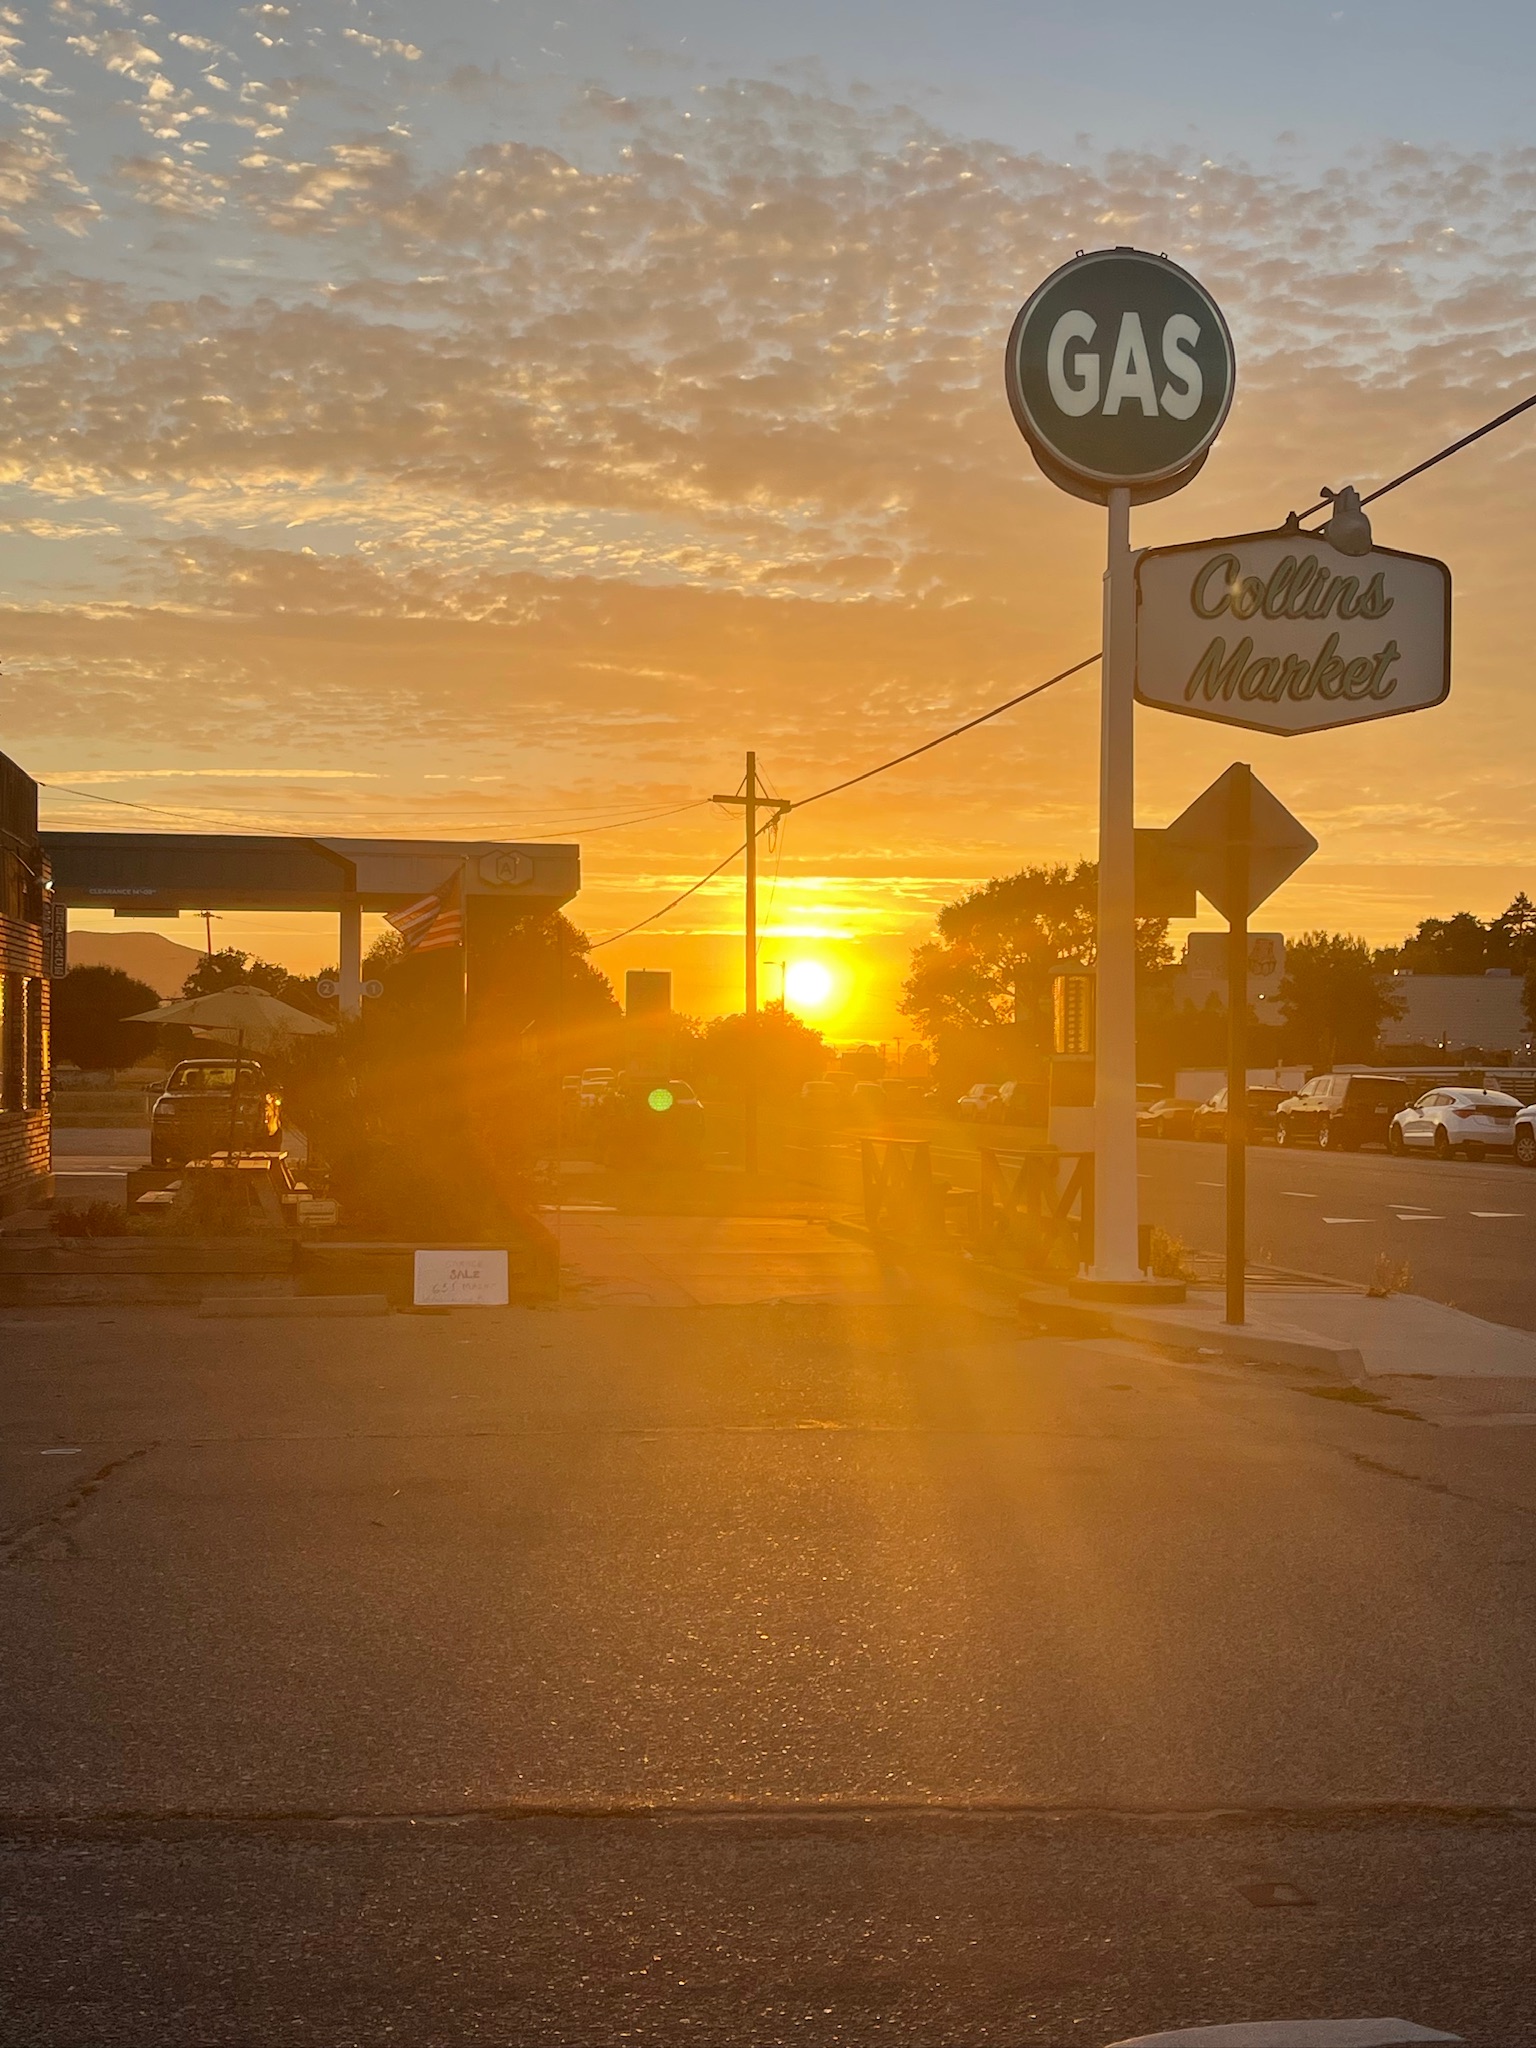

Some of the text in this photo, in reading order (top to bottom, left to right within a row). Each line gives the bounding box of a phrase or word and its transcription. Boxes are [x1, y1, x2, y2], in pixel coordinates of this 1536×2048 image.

[1047, 309, 1203, 421] GAS
[1190, 553, 1395, 621] Collins
[1184, 632, 1401, 702] Market
[89, 888, 132, 896] CLEARANCE
[322, 983, 331, 996] 2
[449, 1269, 481, 1280] SALE
